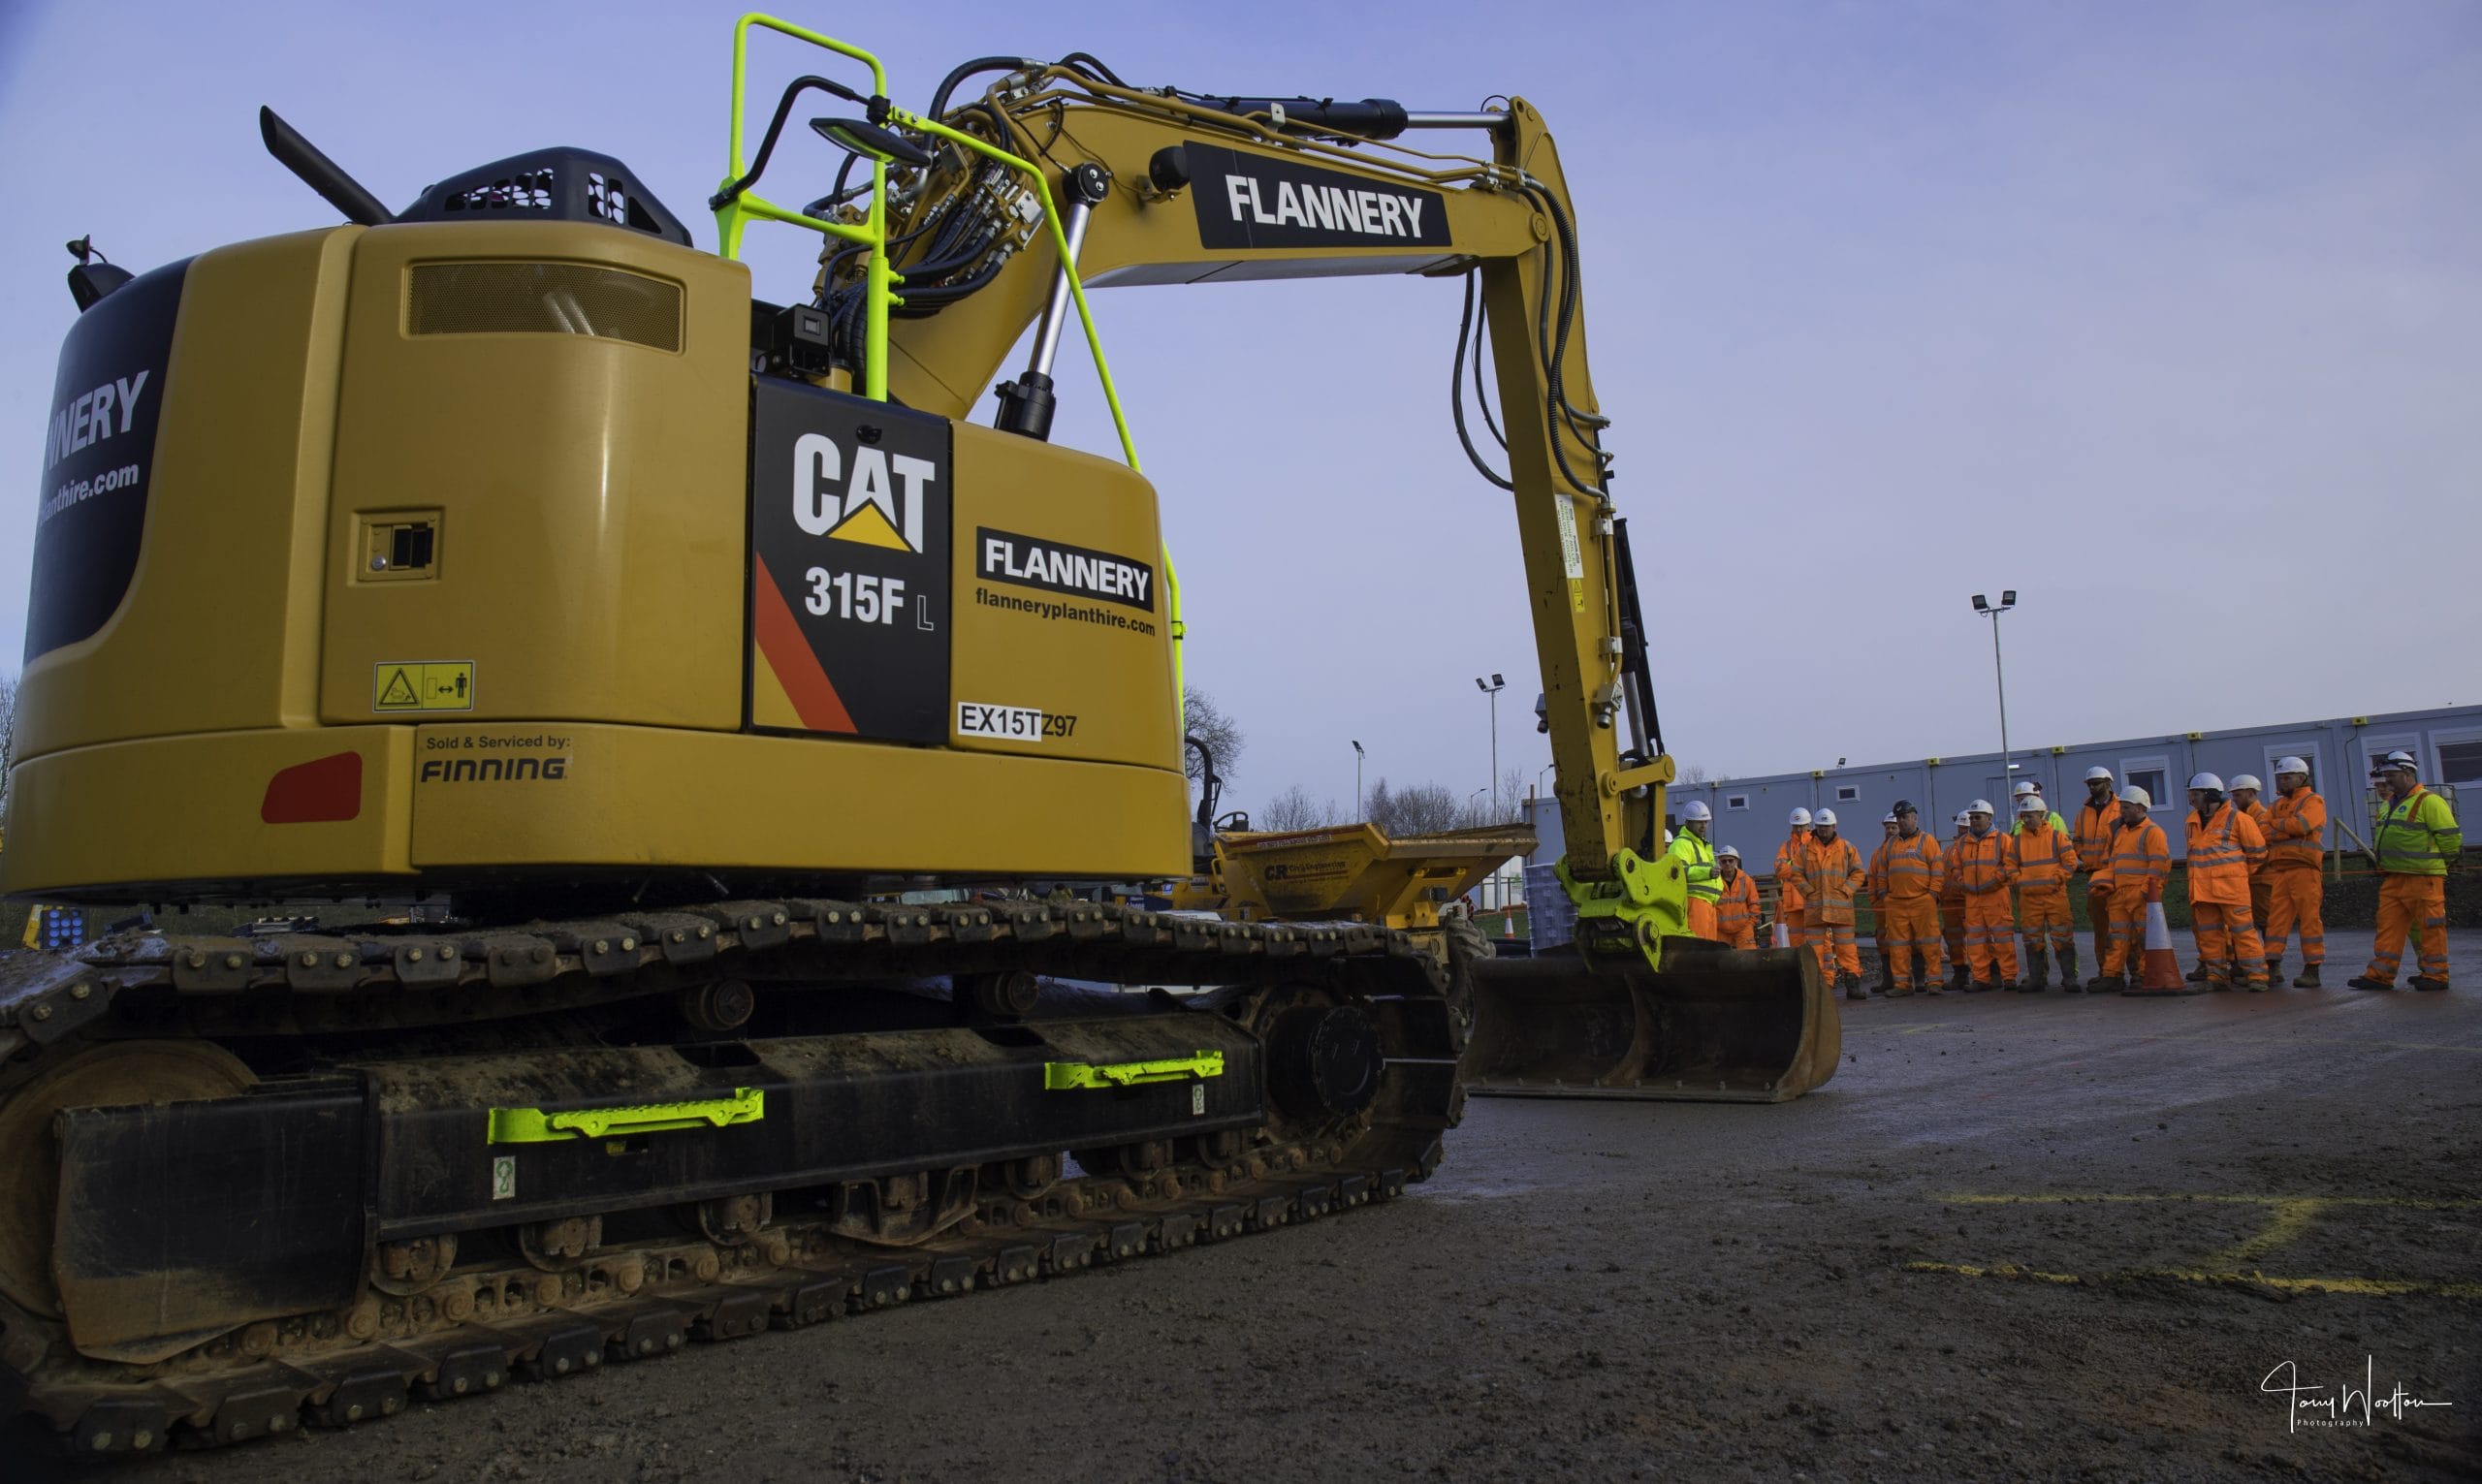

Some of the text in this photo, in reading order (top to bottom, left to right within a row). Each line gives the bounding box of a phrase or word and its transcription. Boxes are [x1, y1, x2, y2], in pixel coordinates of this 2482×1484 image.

[1225, 174, 1422, 238] FLANNERY
[793, 432, 936, 553] CAT
[805, 566, 935, 632] 315F L
[986, 538, 1149, 601] FLANNERY
[975, 587, 1155, 636] flanneryplanthire.com
[421, 758, 565, 782] FINNING
[427, 735, 570, 749] Sold & Serviced by:
